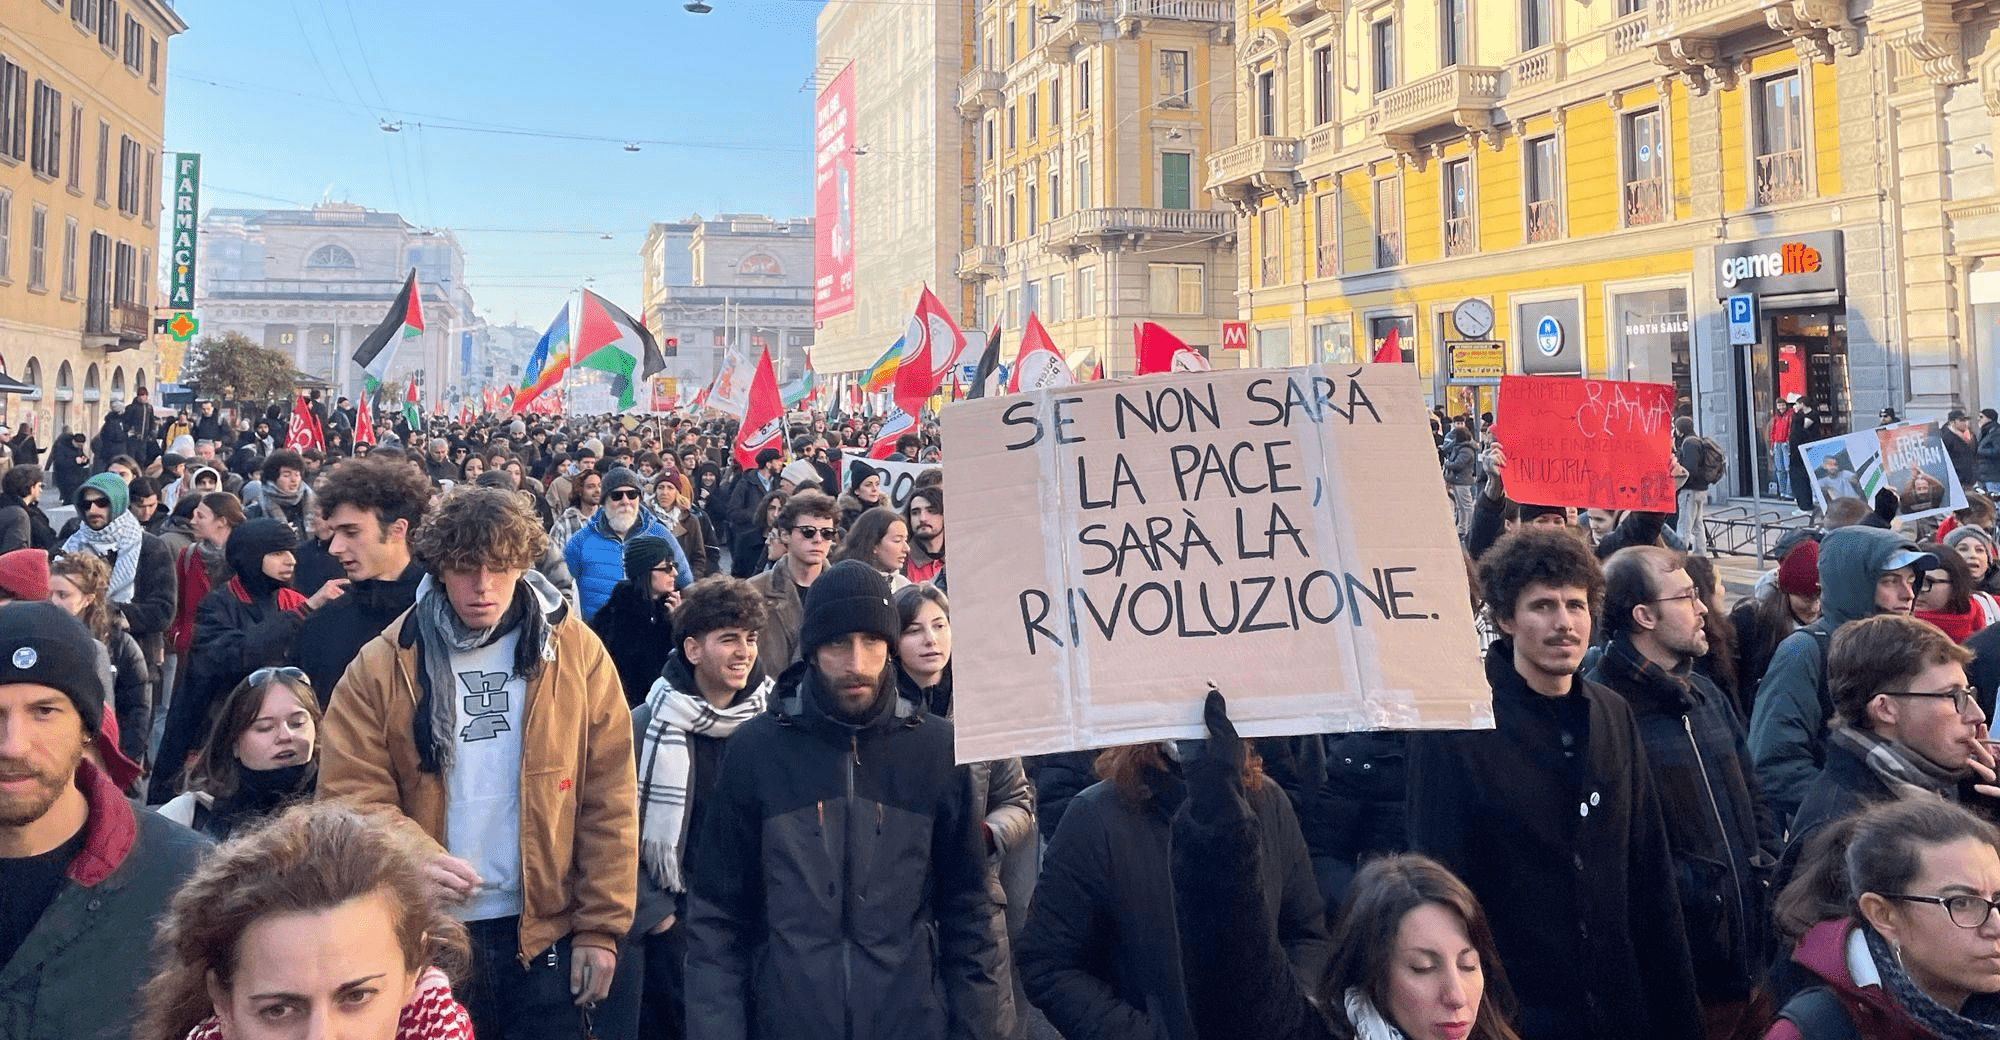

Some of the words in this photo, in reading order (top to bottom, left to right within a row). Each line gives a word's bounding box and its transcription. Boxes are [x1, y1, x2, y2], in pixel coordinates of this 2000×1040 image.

[1722, 242, 1820, 288] gamelife
[1626, 323, 1658, 335] NORTH
[1660, 321, 1688, 334] SAILS
[1735, 300, 1747, 320] P
[1001, 397, 1085, 451] SE
[1116, 382, 1221, 439] NON
[1531, 438, 1557, 452] PER
[1560, 438, 1643, 455] FINANZIARE
[1887, 446, 1941, 472] MARWAN
[1895, 431, 1926, 452] FREE
[1078, 453, 1146, 509] LA
[1170, 440, 1323, 507] PACE,
[1078, 507, 1223, 577] SARÀ
[1235, 502, 1309, 560] LA
[1018, 566, 1440, 655] RIVOLUZIONE.
